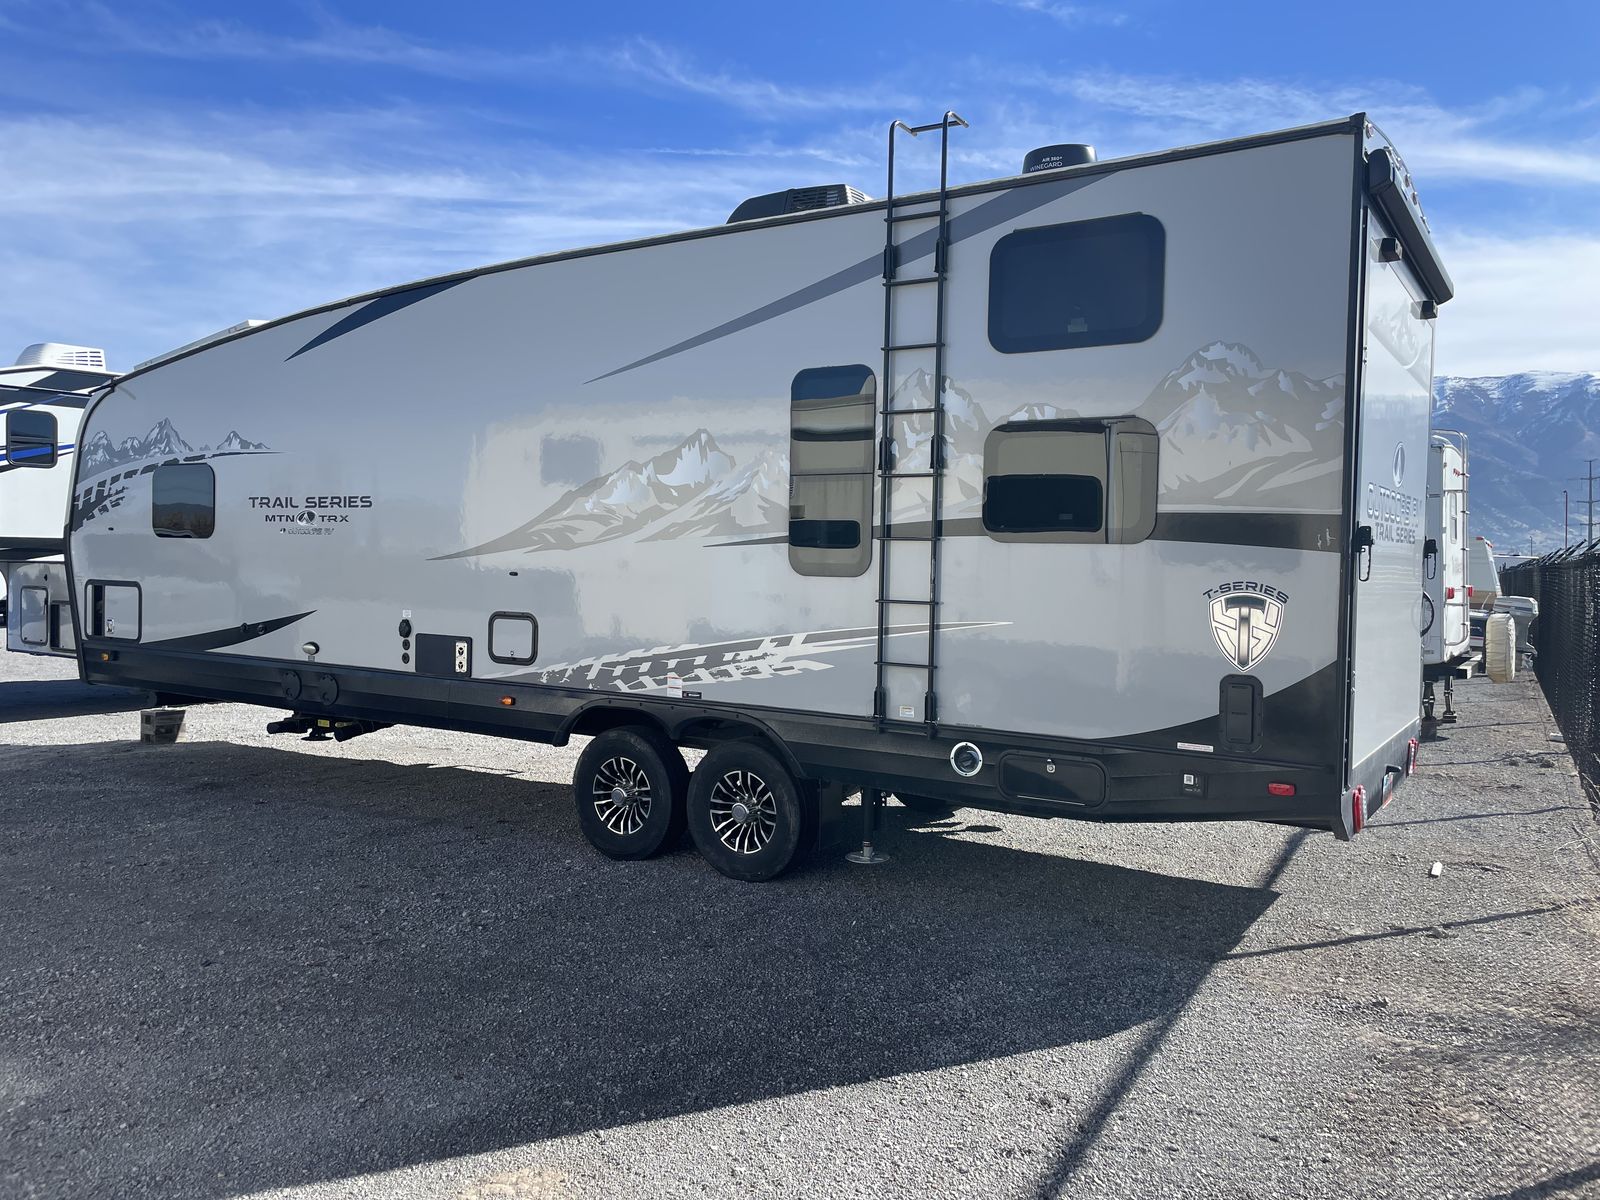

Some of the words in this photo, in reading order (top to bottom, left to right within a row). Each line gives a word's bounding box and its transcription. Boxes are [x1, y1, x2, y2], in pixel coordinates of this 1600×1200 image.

[1030, 161, 1063, 172] WINEGARD
[248, 496, 300, 509] TRAIL
[304, 495, 373, 509] SERIES
[264, 514, 295, 523] MTN
[318, 514, 350, 523] TRX
[1375, 522, 1395, 543] TRAIL
[1203, 581, 1290, 604] T-SERIES
